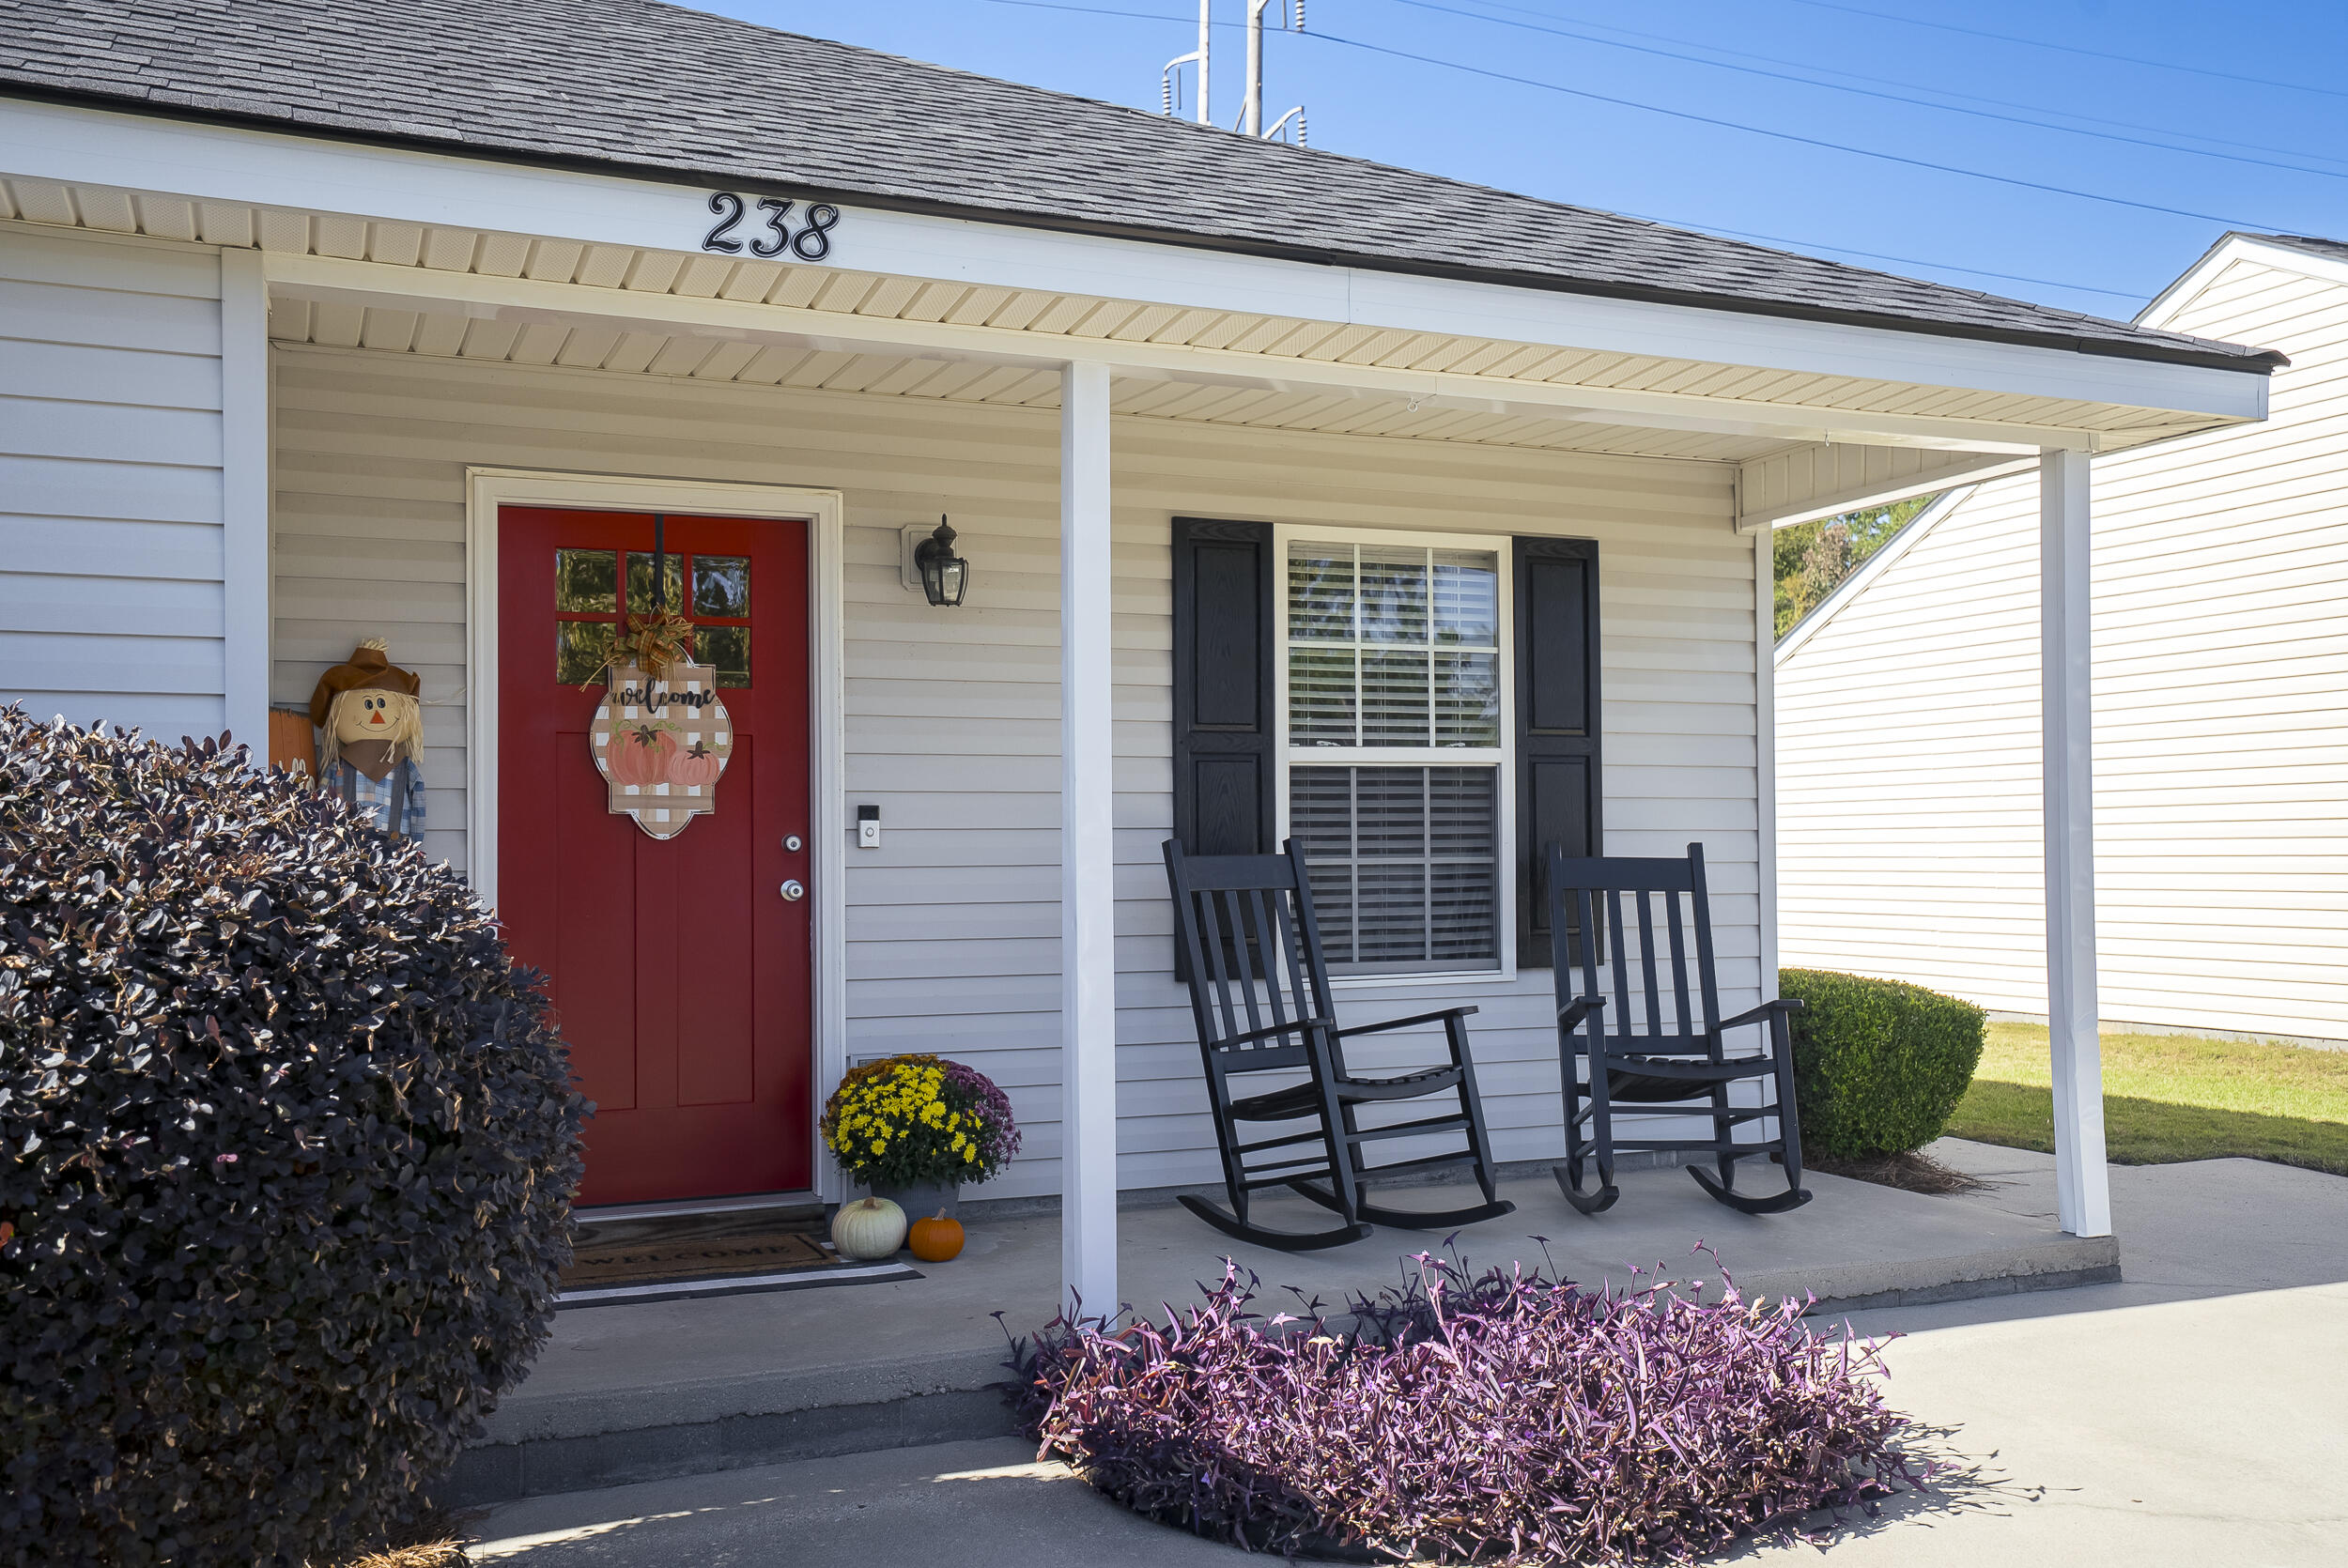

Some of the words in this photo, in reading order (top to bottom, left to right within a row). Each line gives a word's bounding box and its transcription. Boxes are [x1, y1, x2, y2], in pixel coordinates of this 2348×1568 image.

[702, 192, 841, 261] 238
[611, 677, 716, 714] welcome
[580, 1246, 792, 1266] WELCOME
